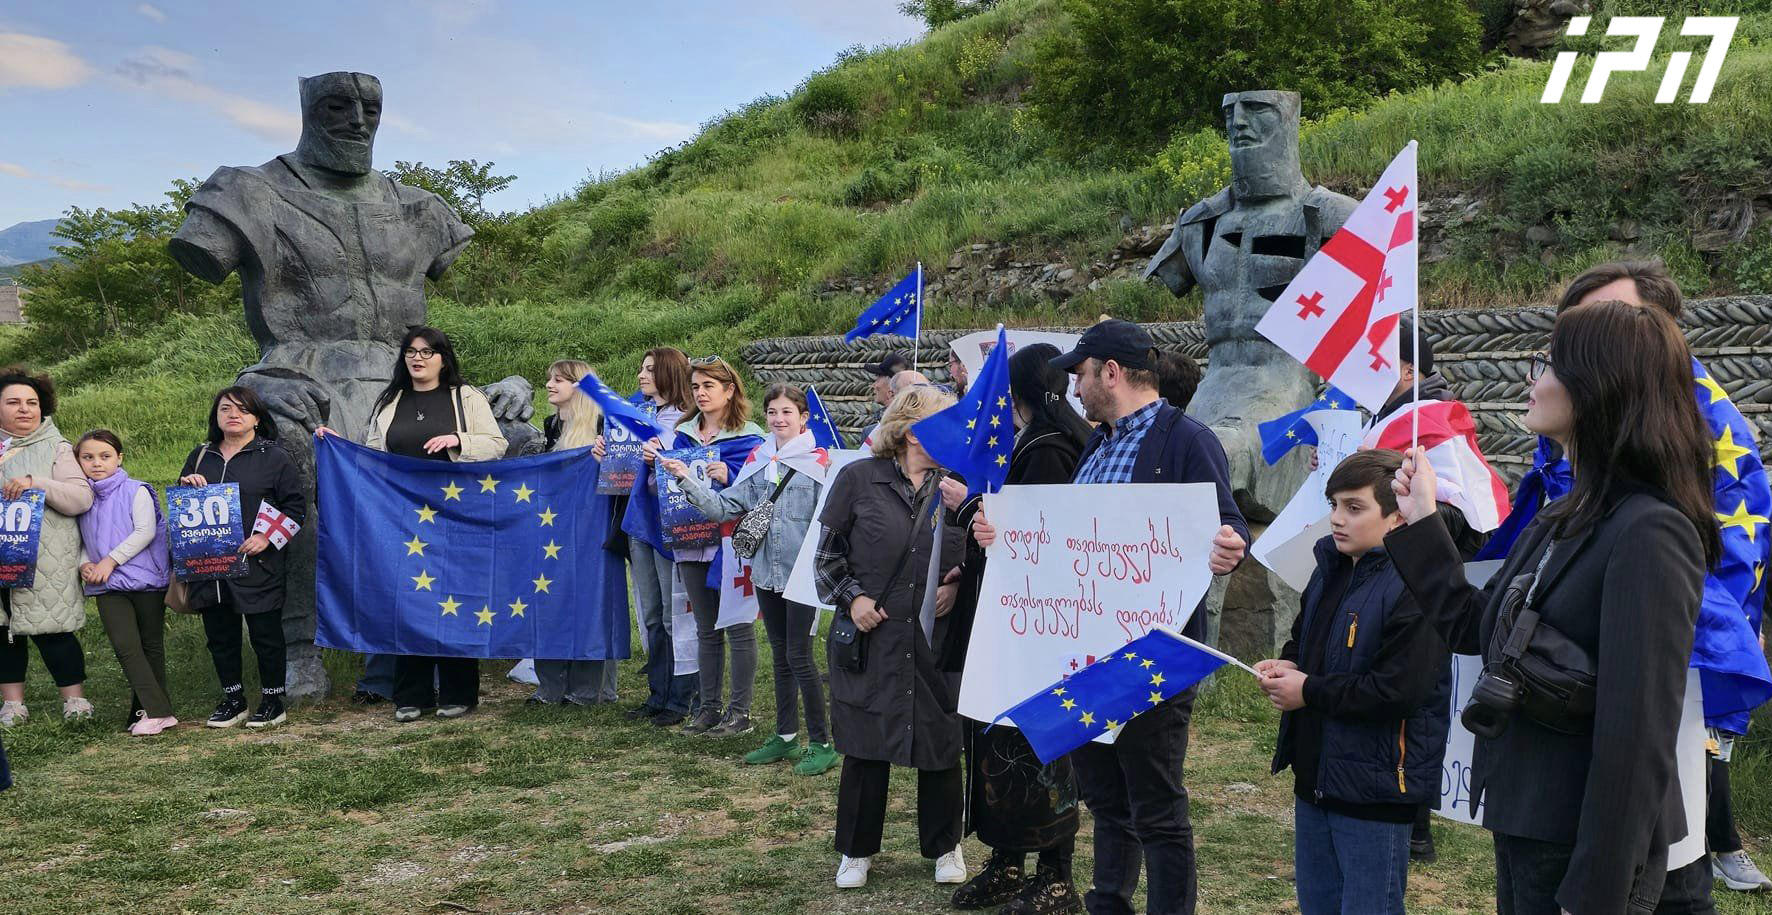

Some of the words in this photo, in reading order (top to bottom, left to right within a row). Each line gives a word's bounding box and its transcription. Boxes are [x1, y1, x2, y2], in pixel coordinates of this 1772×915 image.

[180, 495, 230, 528] კი
[181, 527, 232, 538] ევროპას!
[1003, 510, 1051, 565] დიდება
